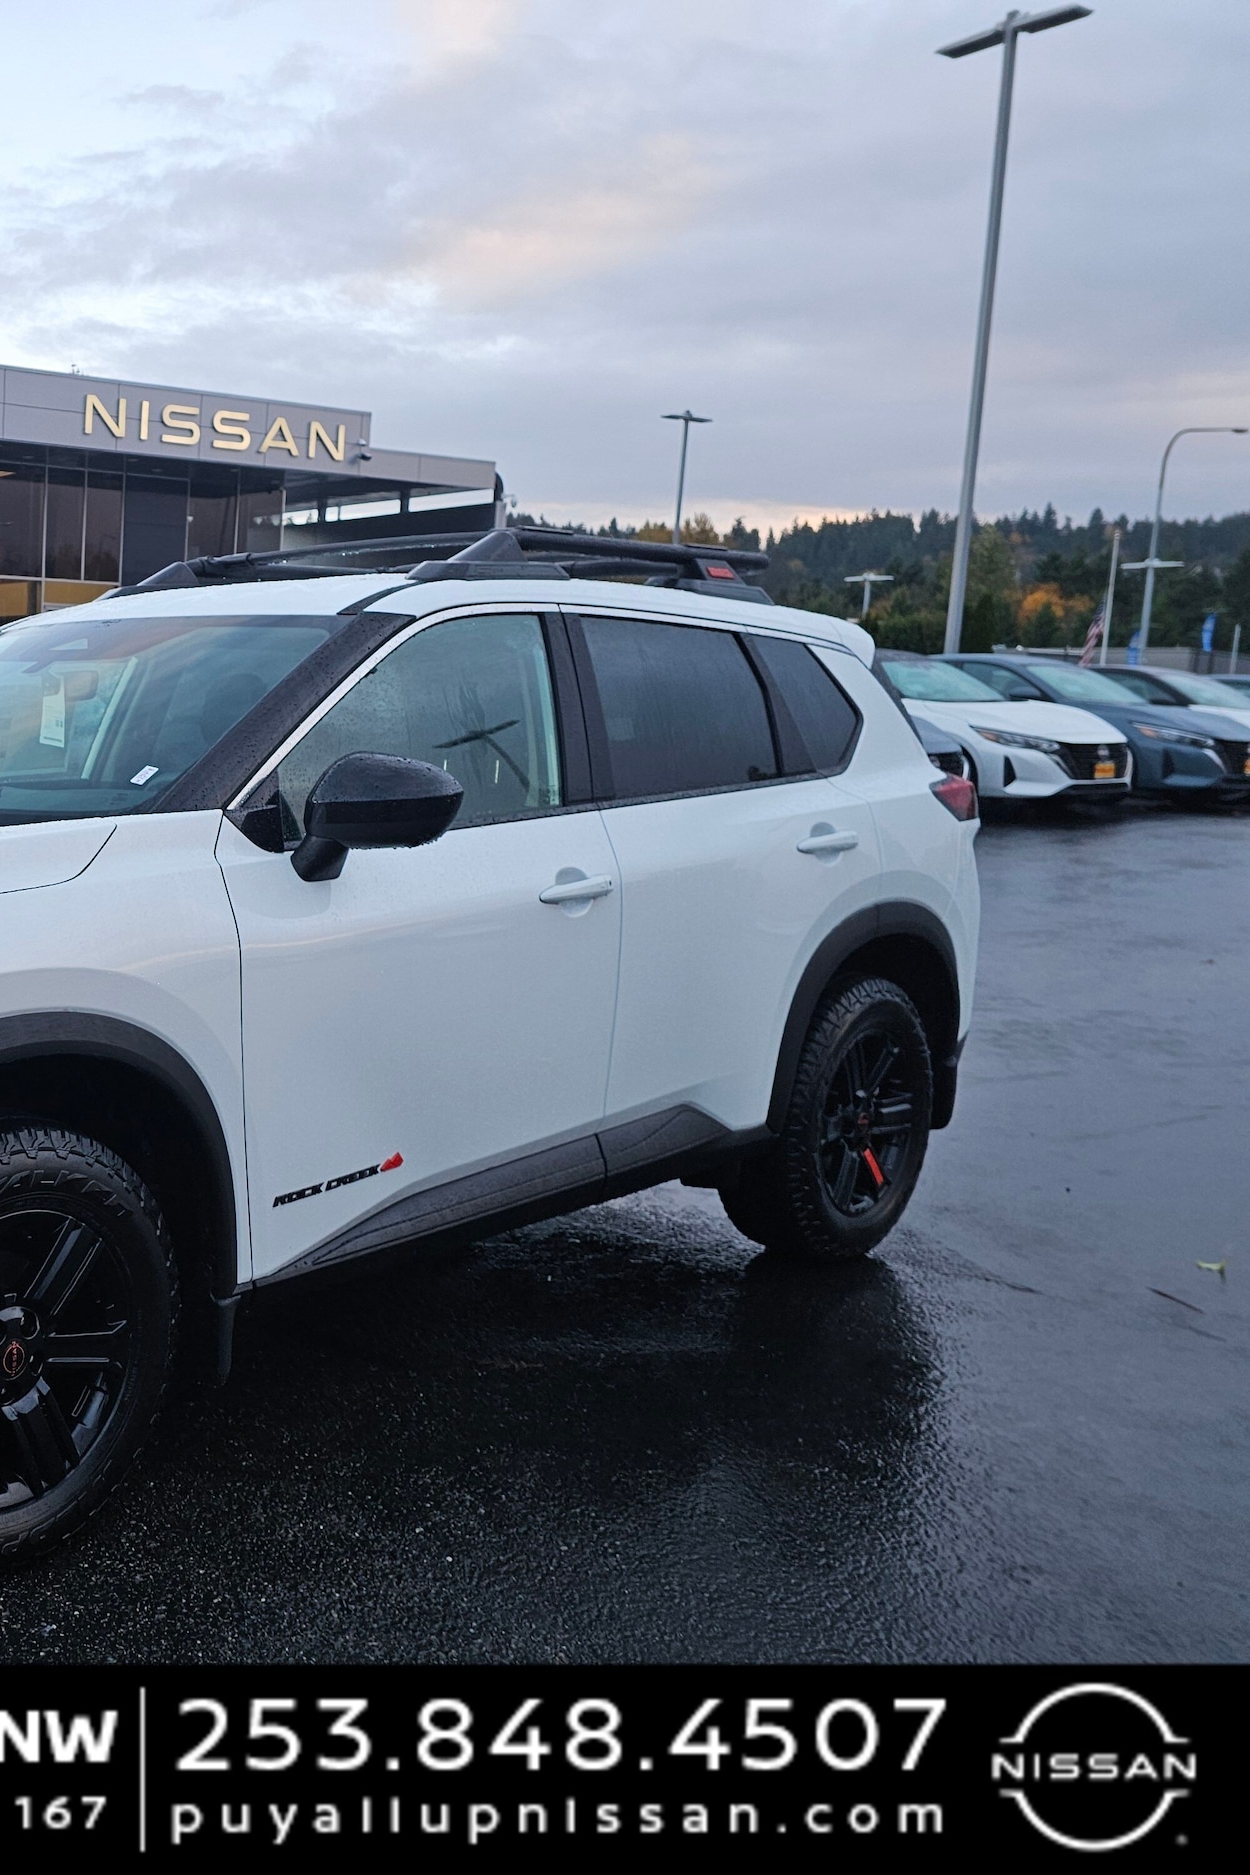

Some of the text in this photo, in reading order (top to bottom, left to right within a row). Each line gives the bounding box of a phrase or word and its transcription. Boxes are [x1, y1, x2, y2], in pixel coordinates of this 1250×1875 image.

[83, 393, 346, 462] NISSAN
[273, 1164, 381, 1208] ROCK CREEK
